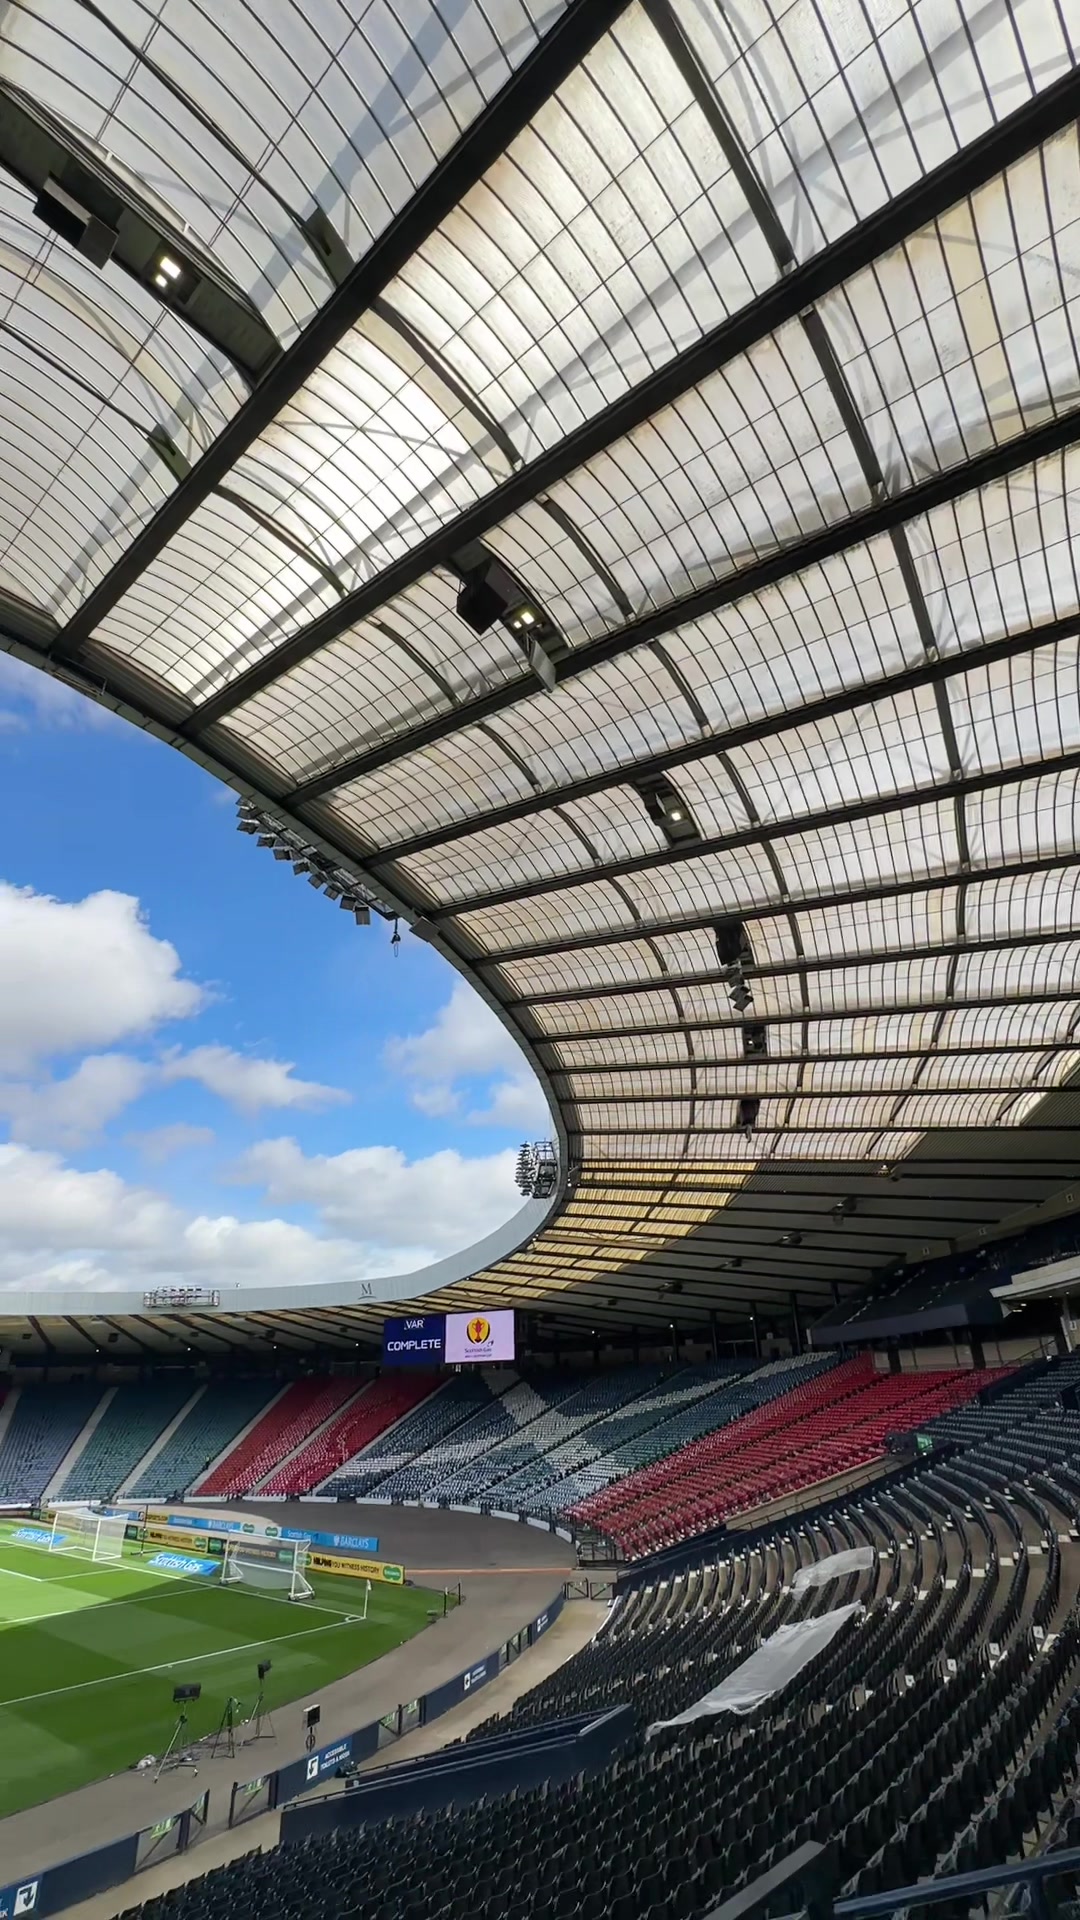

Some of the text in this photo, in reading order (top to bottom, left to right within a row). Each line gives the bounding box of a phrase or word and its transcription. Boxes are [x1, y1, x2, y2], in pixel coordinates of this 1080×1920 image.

[405, 1319, 424, 1329] VAR
[387, 1339, 441, 1351] COMPLETE
[340, 1536, 369, 1549] BARCLAYS
[154, 1553, 203, 1573] Scottish Gas
[313, 1556, 332, 1569] HELPING
[331, 1561, 341, 1569] YOU
[341, 1562, 361, 1572] WITNESS
[360, 1565, 380, 1574] HISTORY
